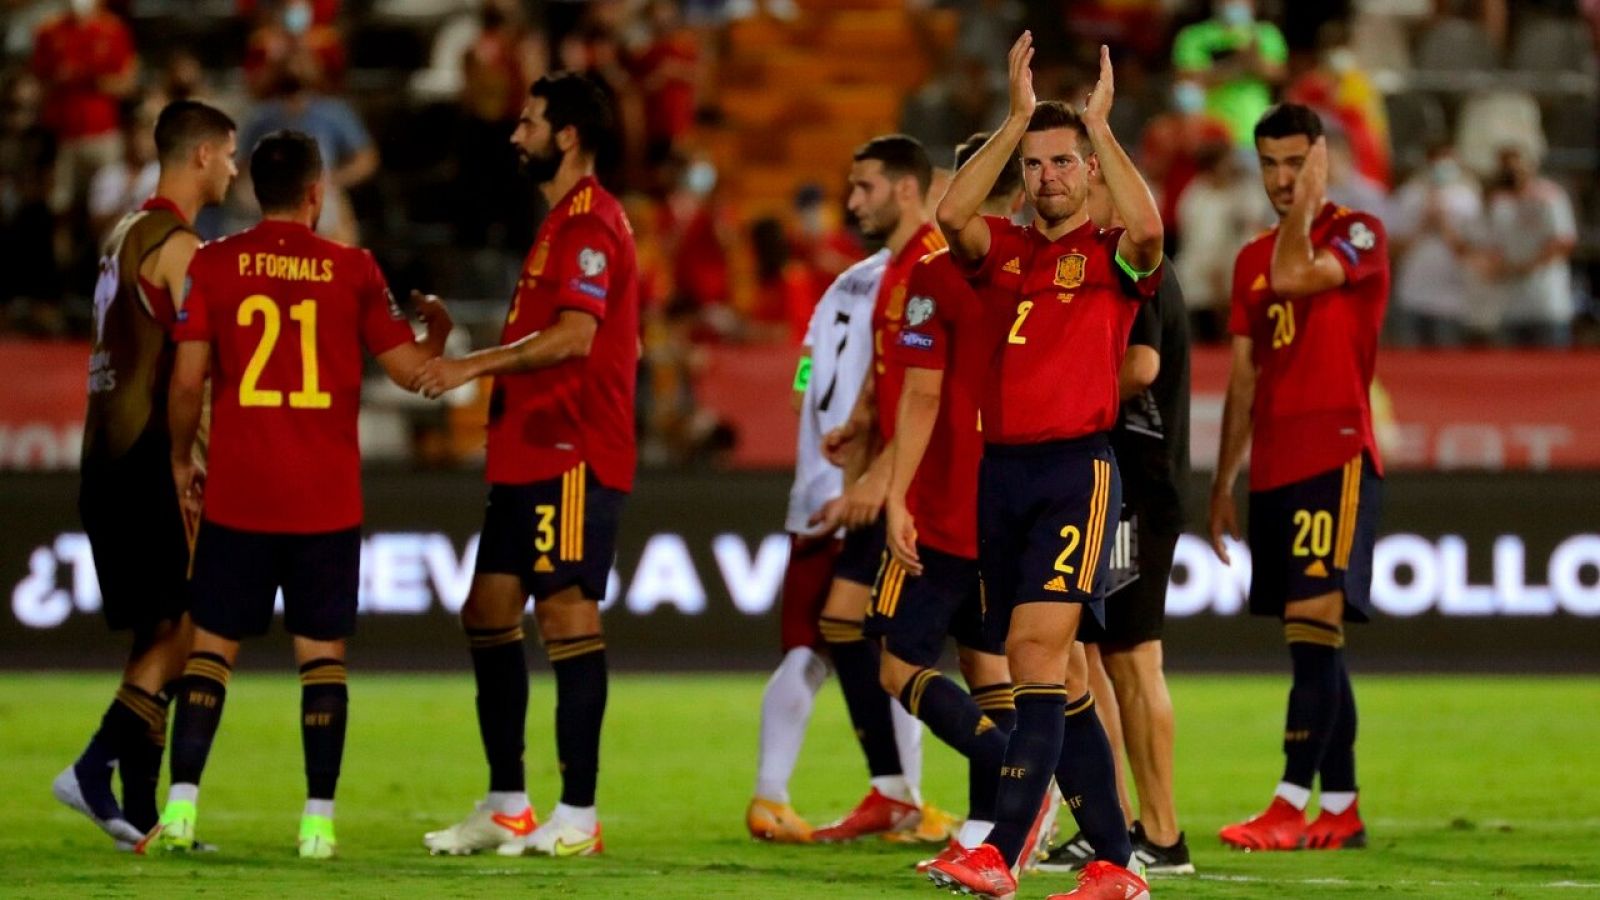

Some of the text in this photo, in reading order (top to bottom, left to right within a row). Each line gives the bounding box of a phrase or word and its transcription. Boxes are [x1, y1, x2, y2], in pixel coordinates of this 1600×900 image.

[1007, 300, 1034, 345] 2
[1267, 301, 1297, 350] 20
[236, 294, 332, 409] 21
[819, 310, 851, 412] 7
[534, 503, 557, 552] 3
[1053, 524, 1081, 575] 2
[1293, 509, 1333, 558] 20
[12, 532, 103, 628] ¿T
[625, 533, 707, 615] A
[711, 533, 791, 615] V
[1370, 533, 1600, 616] OLLO
